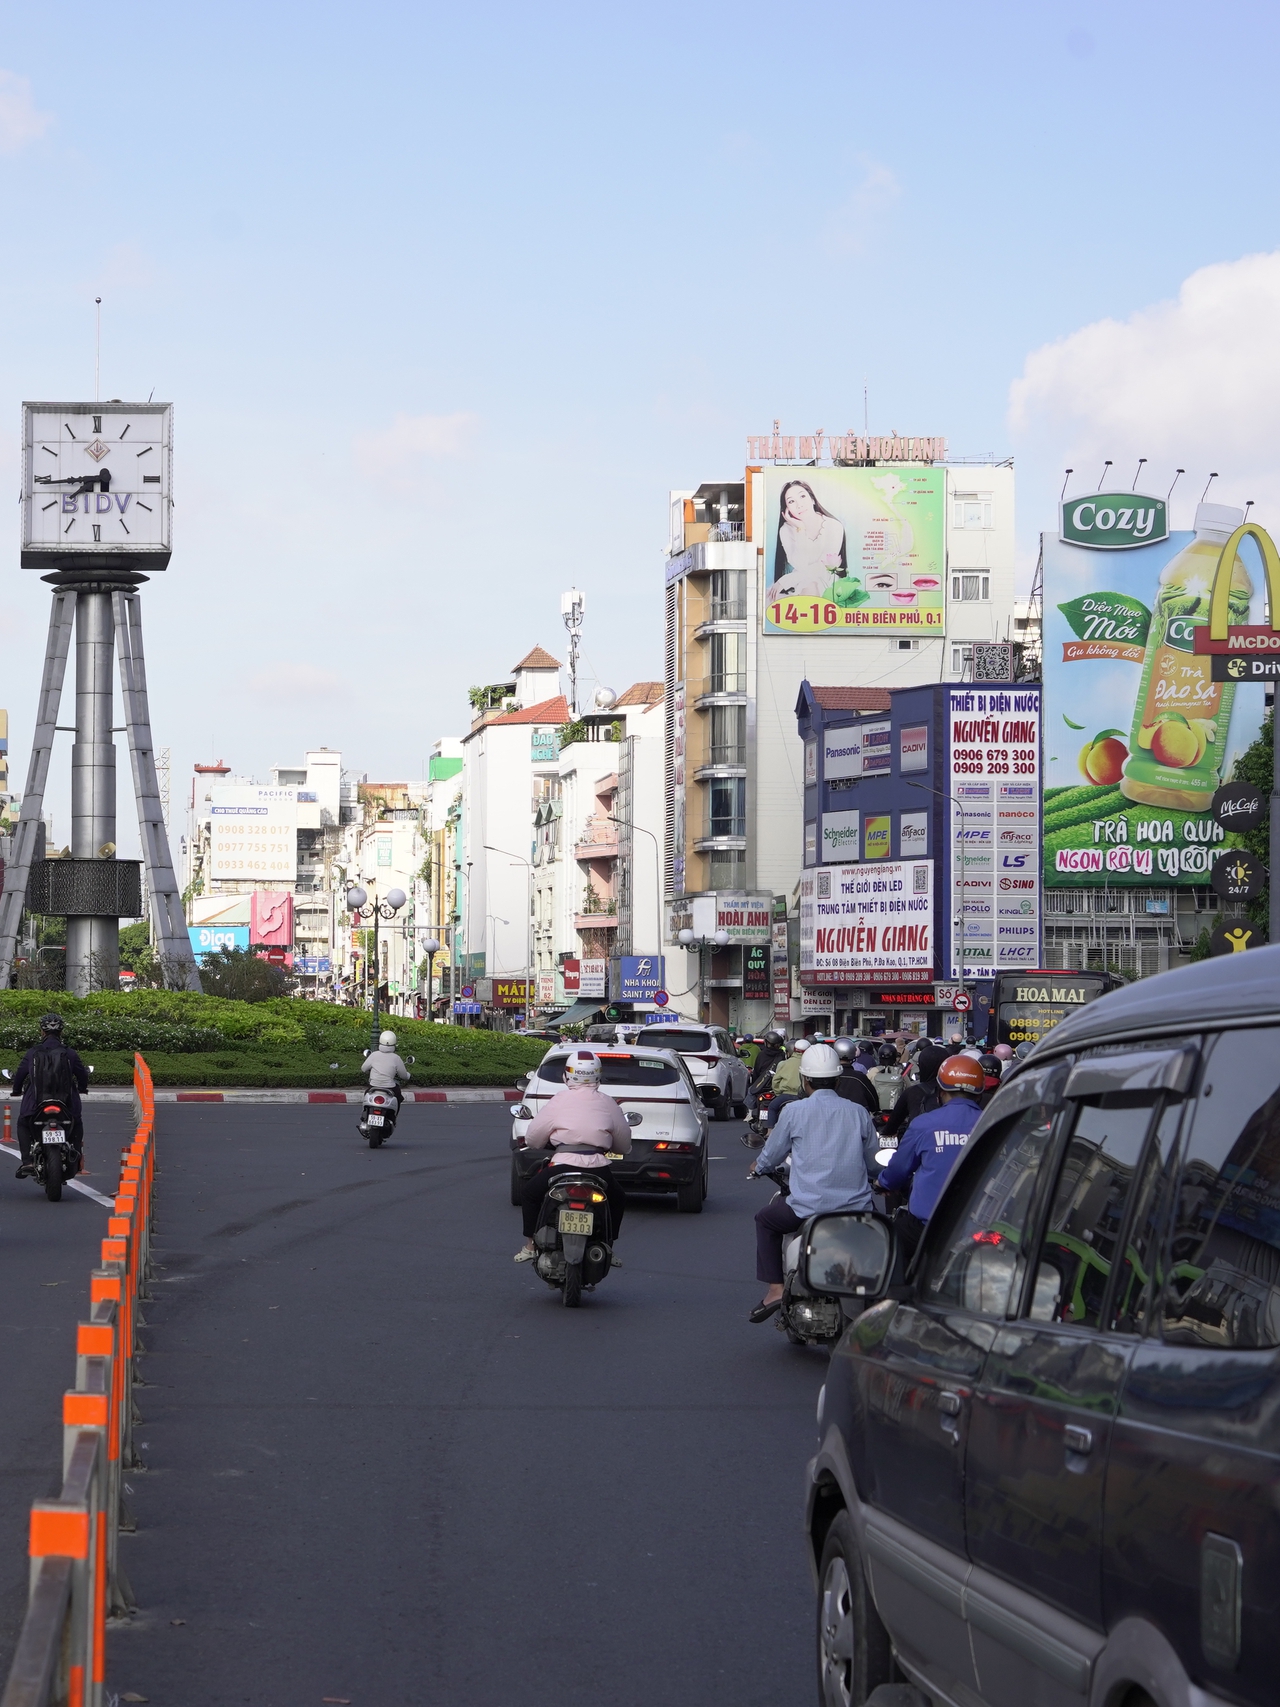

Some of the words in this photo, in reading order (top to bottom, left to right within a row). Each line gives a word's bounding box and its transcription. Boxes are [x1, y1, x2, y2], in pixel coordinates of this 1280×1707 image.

[868, 429, 911, 460] HOÀI
[912, 436, 946, 461] ANH
[62, 493, 132, 514] BIDV
[1072, 503, 1155, 538] Cozy
[771, 603, 837, 625] 14-16
[1081, 599, 1113, 613] Diện
[1114, 604, 1142, 620] Mạo
[844, 610, 869, 626] ĐIỆN
[872, 610, 897, 624] BIÊN
[1083, 615, 1141, 641] Mới
[1067, 645, 1084, 658] Gu
[1086, 647, 1119, 660] không
[1181, 667, 1204, 678] Trà
[1154, 680, 1190, 700] Đào
[951, 690, 975, 711] THIẾT
[978, 695, 986, 715] BỊ
[989, 692, 1011, 715] ĐIỆN
[1014, 692, 1038, 712] NƯỚC
[953, 714, 999, 743] NGUYỄN
[1002, 721, 1035, 743] GIANG
[826, 744, 860, 758] Panasonic
[902, 743, 925, 753] CADIVI
[953, 749, 983, 760] 0906
[986, 749, 1008, 761] 679
[1012, 749, 1035, 761] 300
[953, 762, 983, 773] 0909
[987, 763, 1009, 774] 209
[1013, 763, 1035, 774] 300
[1220, 798, 1258, 816] McCafé
[218, 825, 245, 834] 0908
[248, 826, 267, 834] 328
[270, 826, 290, 834] 017
[824, 826, 858, 841] Schneider
[1092, 815, 1128, 843] TRÀ
[1137, 820, 1174, 843] HOA
[867, 830, 888, 841] MPE
[218, 843, 245, 852] 0977
[247, 843, 267, 852] 755
[270, 844, 289, 852] 751
[1003, 856, 1025, 867] LS
[1058, 850, 1101, 870] NGON
[1109, 847, 1130, 869] RÕ
[1184, 847, 1207, 869] RÕ
[218, 861, 244, 869] 0933
[247, 861, 267, 870] 462
[270, 862, 290, 870] 404
[841, 865, 902, 876] www.nguyengiang.vn
[841, 879, 855, 894] THẾ
[856, 879, 871, 893] GIỚI
[873, 878, 887, 892] ĐÈN
[889, 880, 903, 891] LED
[1012, 880, 1034, 889] SINO
[1228, 886, 1249, 894] 24/7
[751, 901, 764, 910] VIỆN
[817, 903, 840, 915] TRUNG
[842, 900, 856, 914] TÂM
[858, 897, 878, 913] THIẾT
[880, 901, 887, 915] BỊ
[889, 897, 906, 915] ĐIỆN
[908, 896, 928, 911] NƯỚC
[718, 909, 744, 926] HOÀI
[747, 911, 769, 926] ANH
[742, 928, 756, 936] BIÊN
[816, 916, 877, 953] NGUYỄN
[882, 925, 929, 952] GIANG
[999, 927, 1035, 935] PHILIPS
[955, 948, 992, 956] TOTAL
[1000, 947, 1034, 956] LHCT
[748, 960, 765, 969] QUY
[498, 980, 526, 996] MẮT
[624, 979, 640, 987] NHA
[641, 979, 661, 987] KHOA
[622, 991, 643, 999] SAINT
[881, 994, 896, 1004] NHẬN
[908, 993, 923, 1003] HÀNG
[1016, 987, 1049, 1002] HOA
[1051, 988, 1085, 1002] MAI
[564, 1212, 589, 1223] 86-B5
[562, 1223, 591, 1234] 133.03
